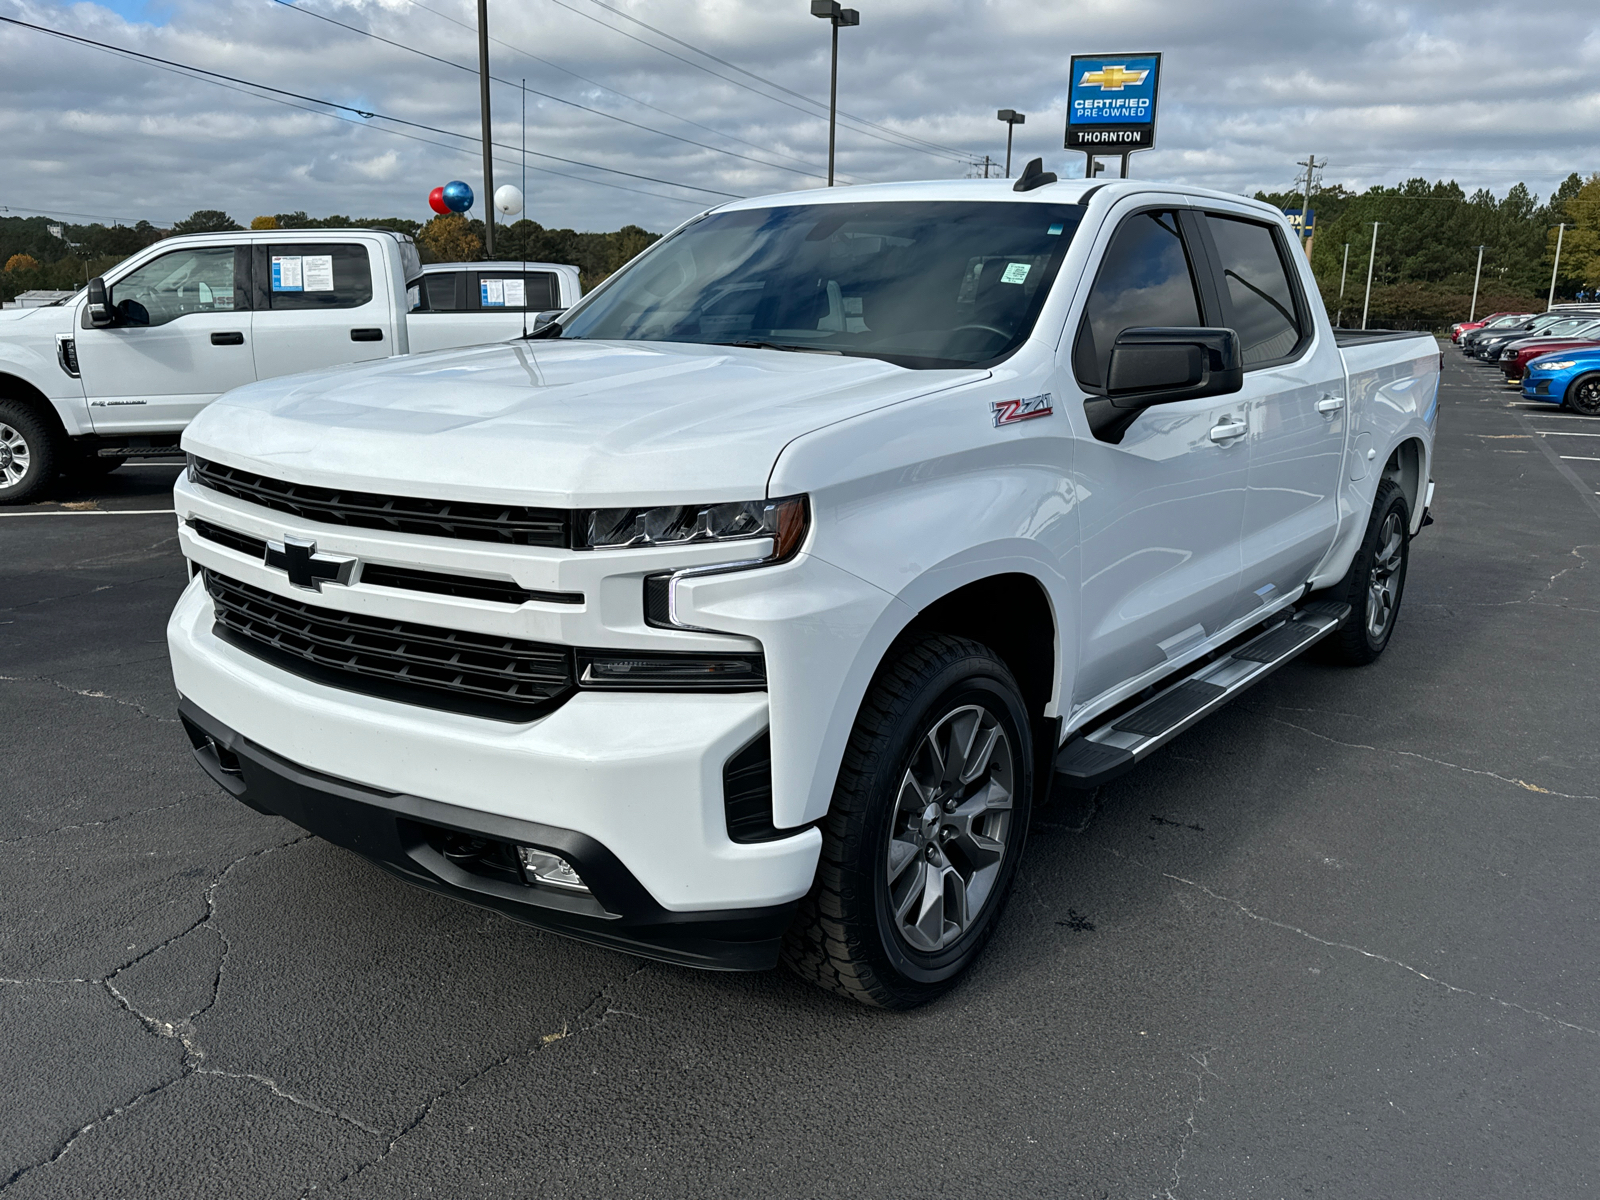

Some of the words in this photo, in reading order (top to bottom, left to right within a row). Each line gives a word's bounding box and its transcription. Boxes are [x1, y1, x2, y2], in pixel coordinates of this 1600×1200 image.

[1074, 98, 1149, 108] CERTIFIED
[1077, 108, 1145, 117] PRE-OWNED
[1077, 132, 1141, 142] THORNTON
[989, 393, 1053, 428] Z71
